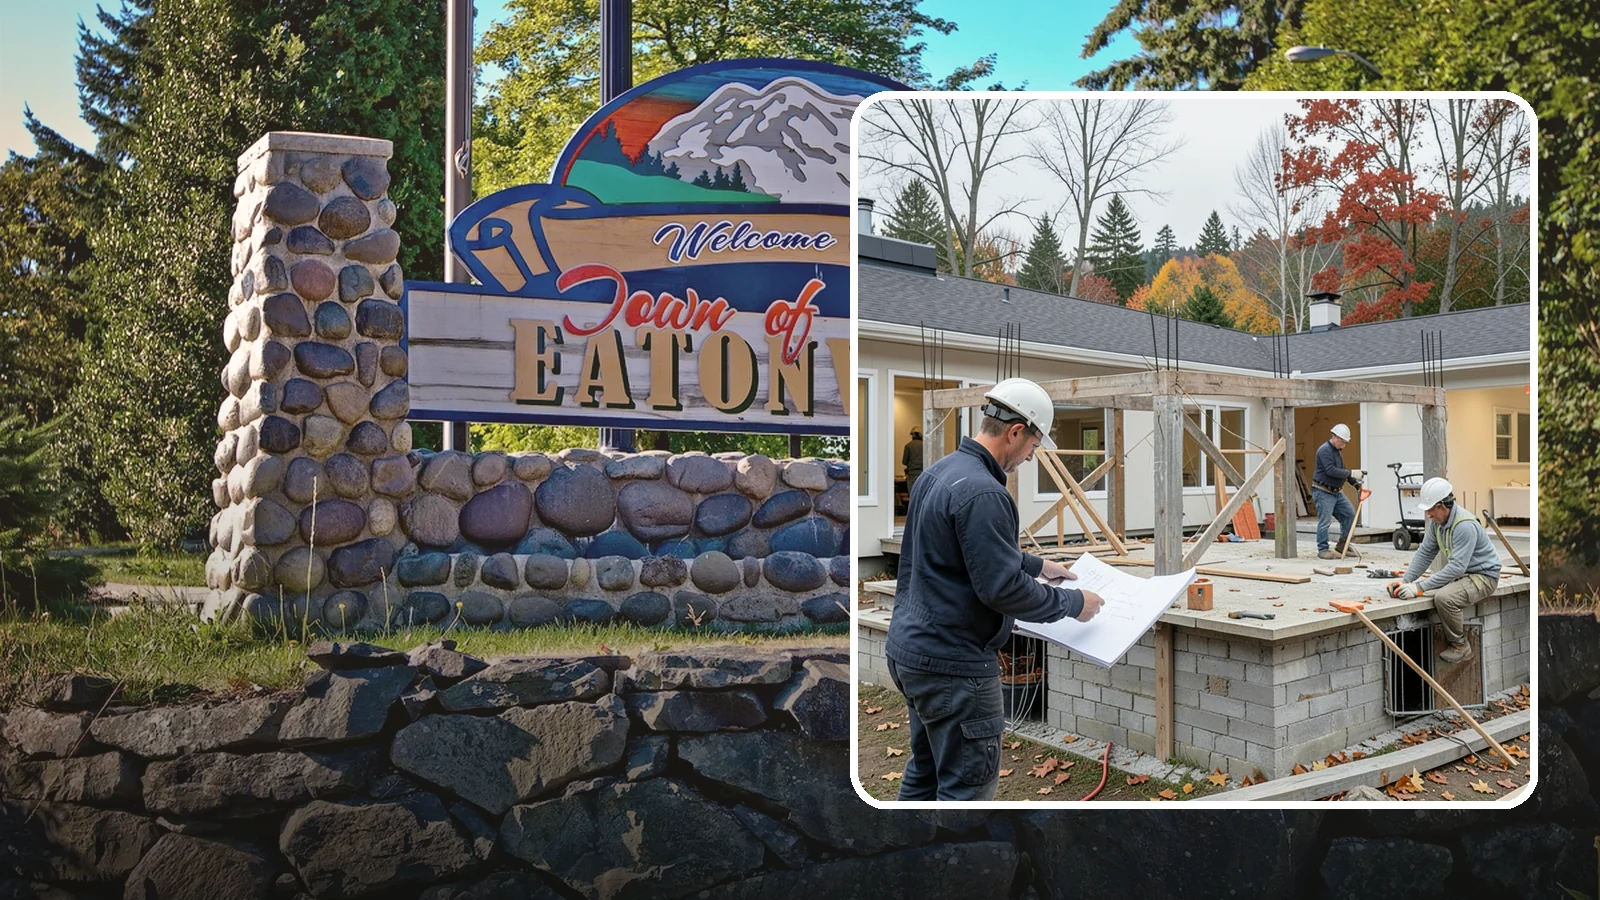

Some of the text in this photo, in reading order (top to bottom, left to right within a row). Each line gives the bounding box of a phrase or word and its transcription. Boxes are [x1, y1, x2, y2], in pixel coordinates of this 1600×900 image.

[653, 221, 836, 263] Welcome
[557, 264, 825, 365] Town of
